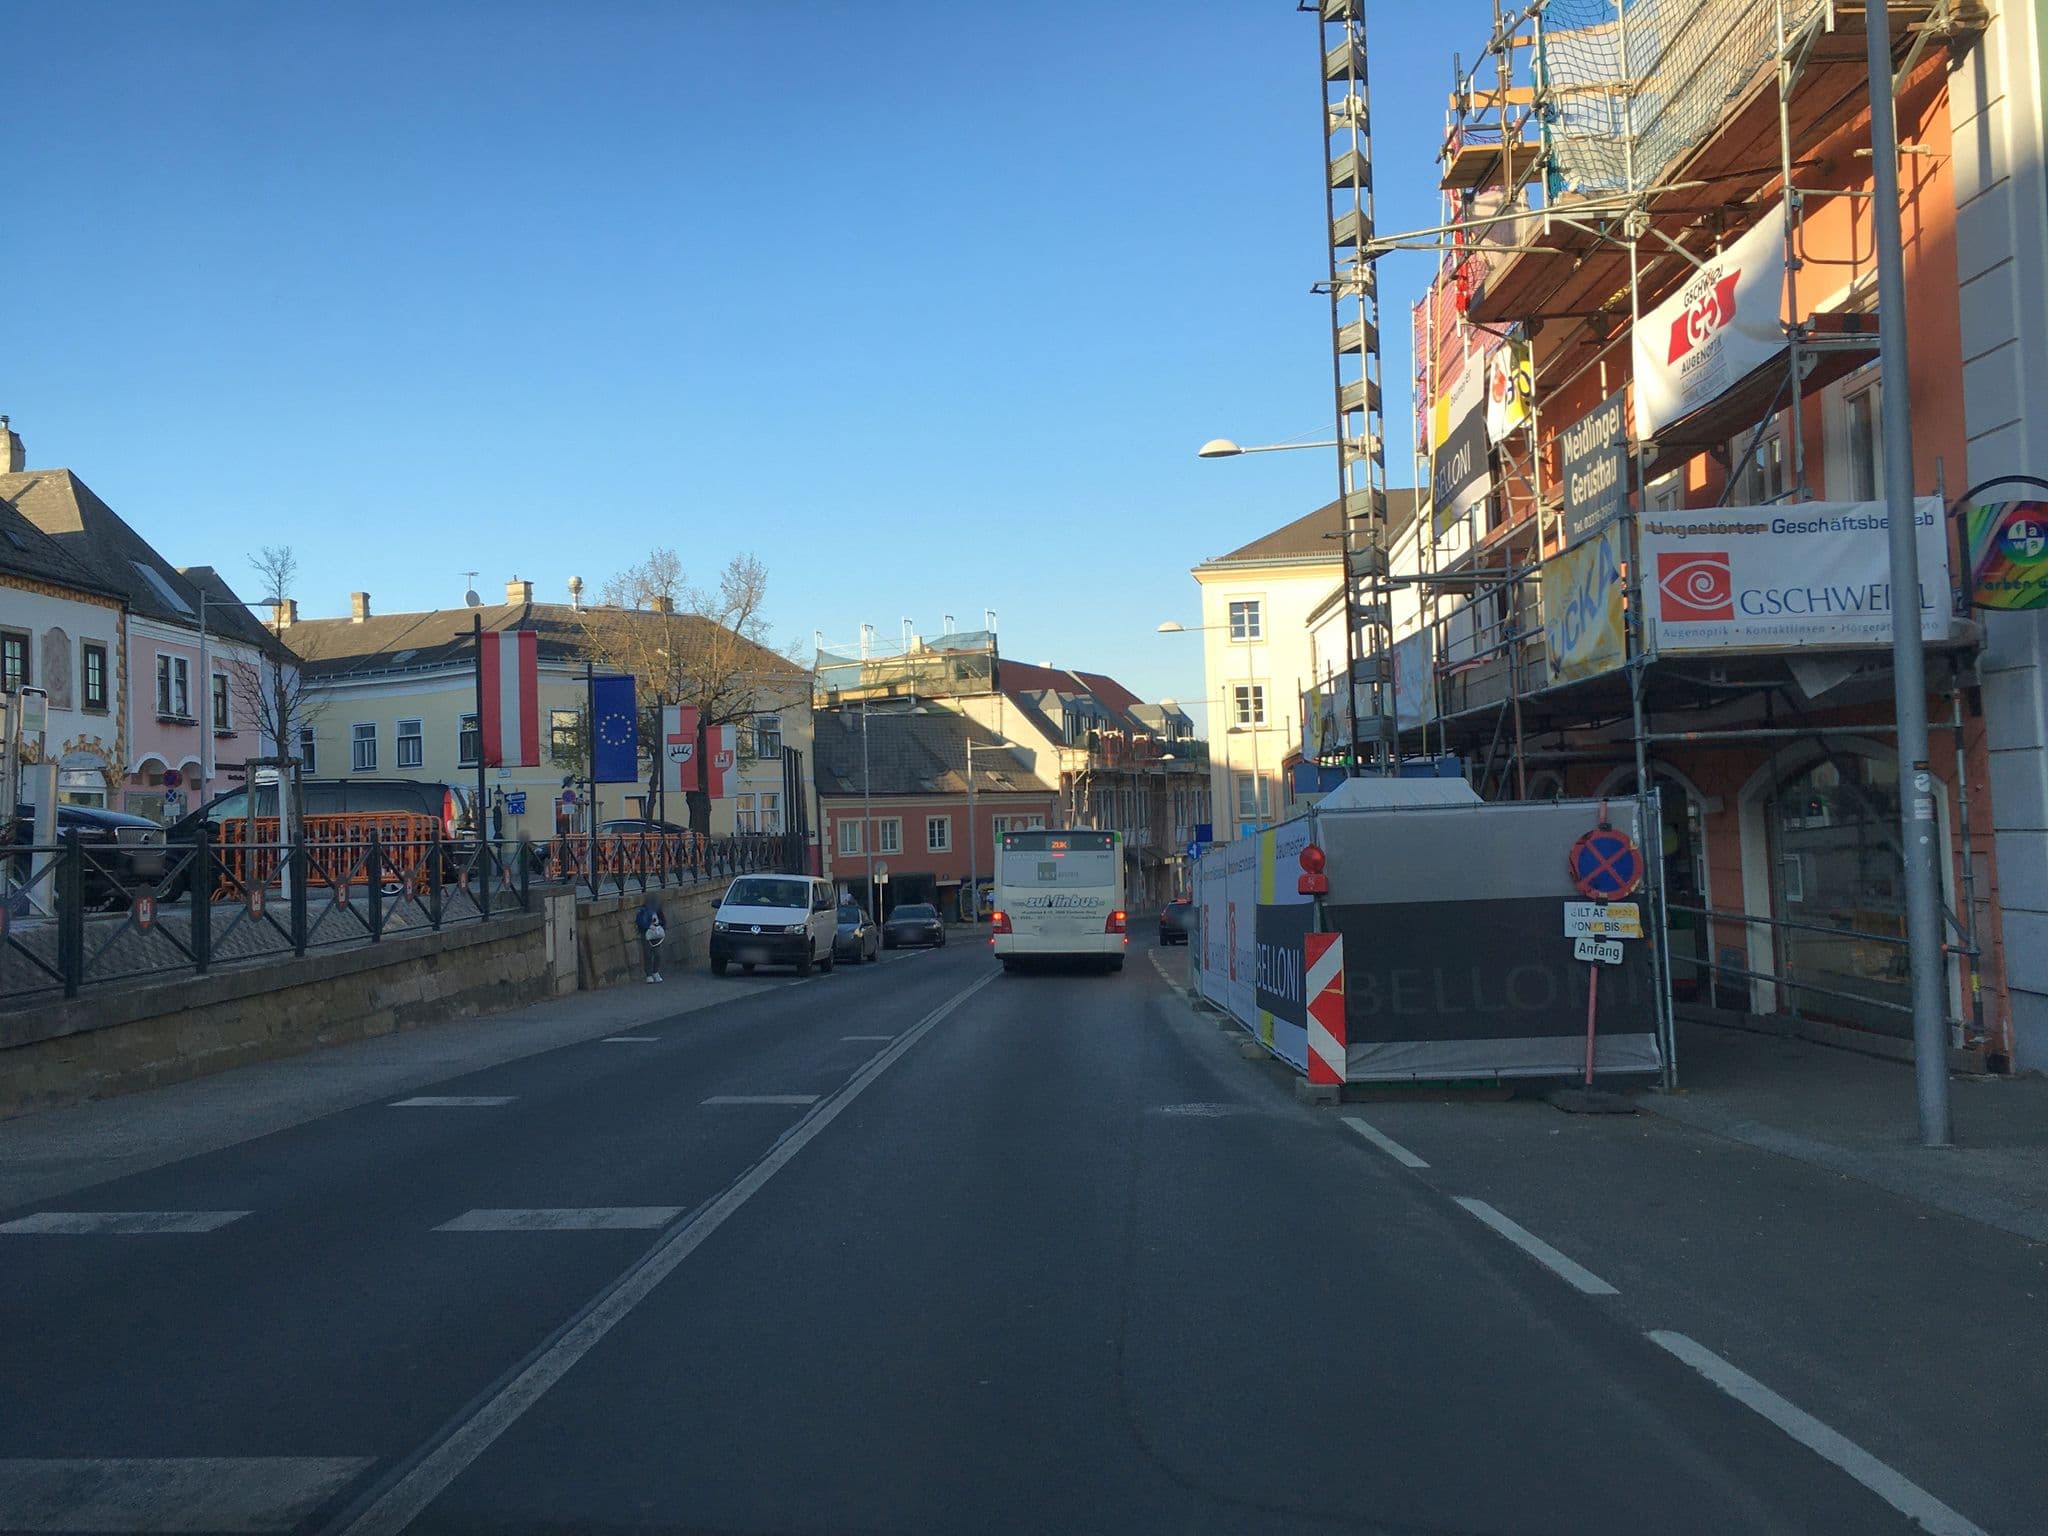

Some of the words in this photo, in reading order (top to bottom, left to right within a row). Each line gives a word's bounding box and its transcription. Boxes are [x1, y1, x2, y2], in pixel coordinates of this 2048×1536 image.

[1571, 455, 1618, 507] Gerüstbau
[1739, 583, 1936, 616] GSCHWEIL
[1662, 627, 1730, 639] Augenoptik
[1745, 625, 1826, 637] Kontaktlinsen
[1604, 922, 1621, 932] BIS
[1578, 942, 1620, 960] Anfang
[1256, 943, 1300, 1003] BELLONI
